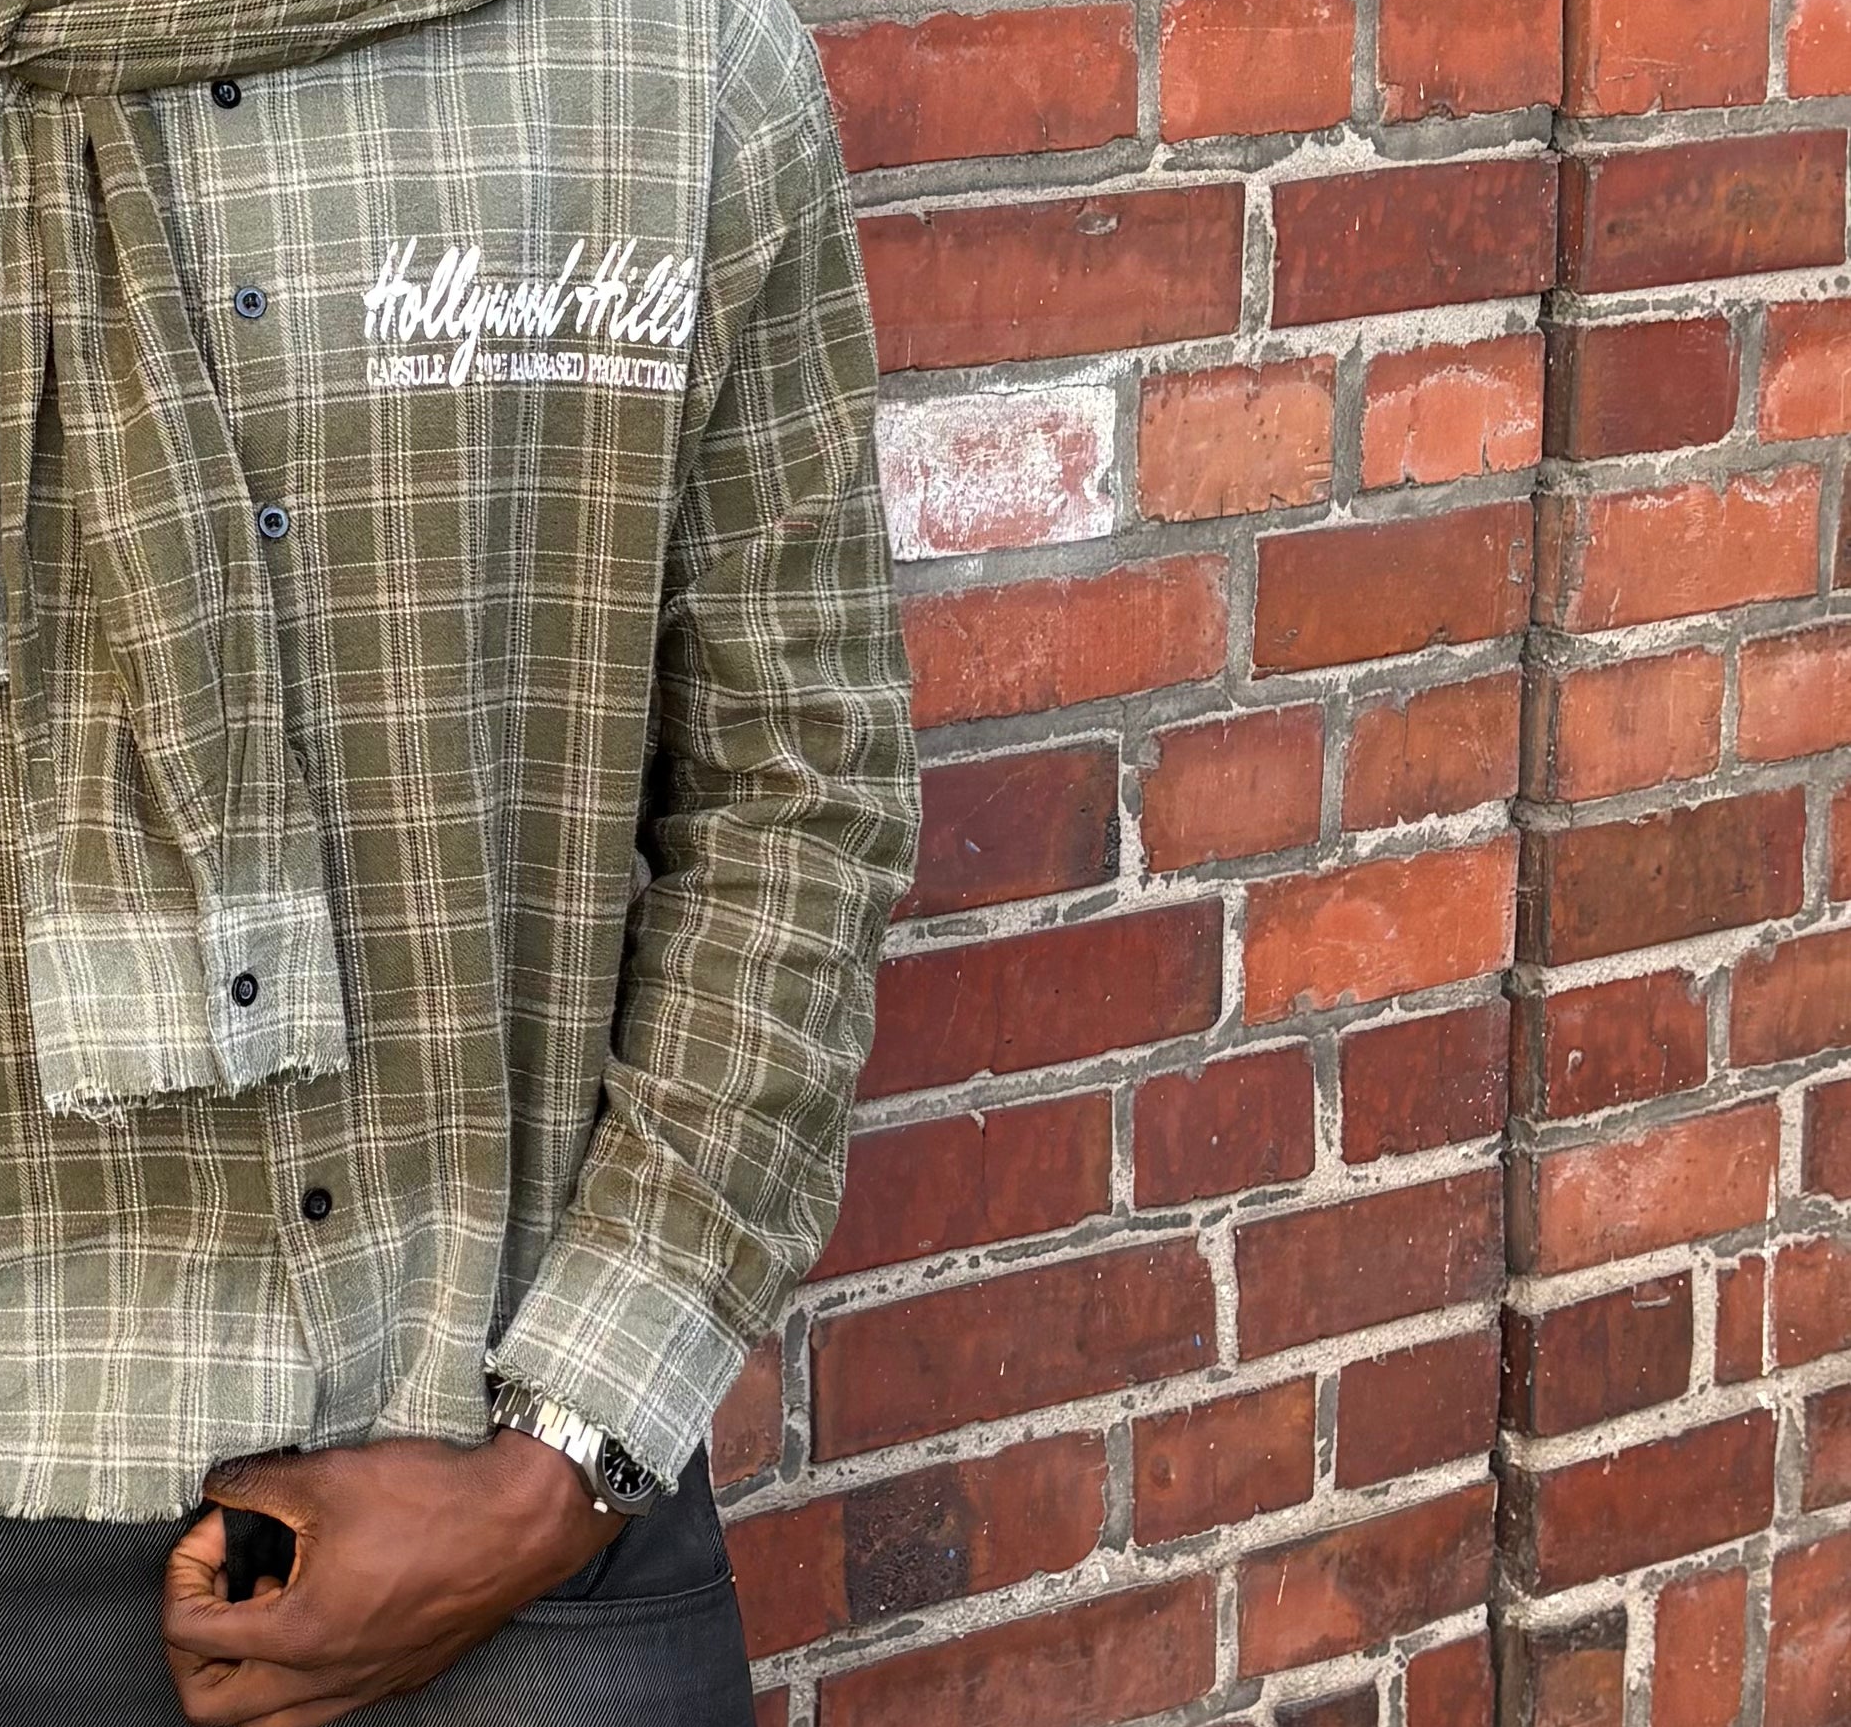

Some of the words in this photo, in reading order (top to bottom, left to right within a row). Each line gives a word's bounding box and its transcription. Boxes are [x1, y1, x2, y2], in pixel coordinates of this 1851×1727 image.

[362, 235, 585, 388] Hollywood
[575, 237, 696, 347] Hills
[366, 353, 447, 387] CAPSULE
